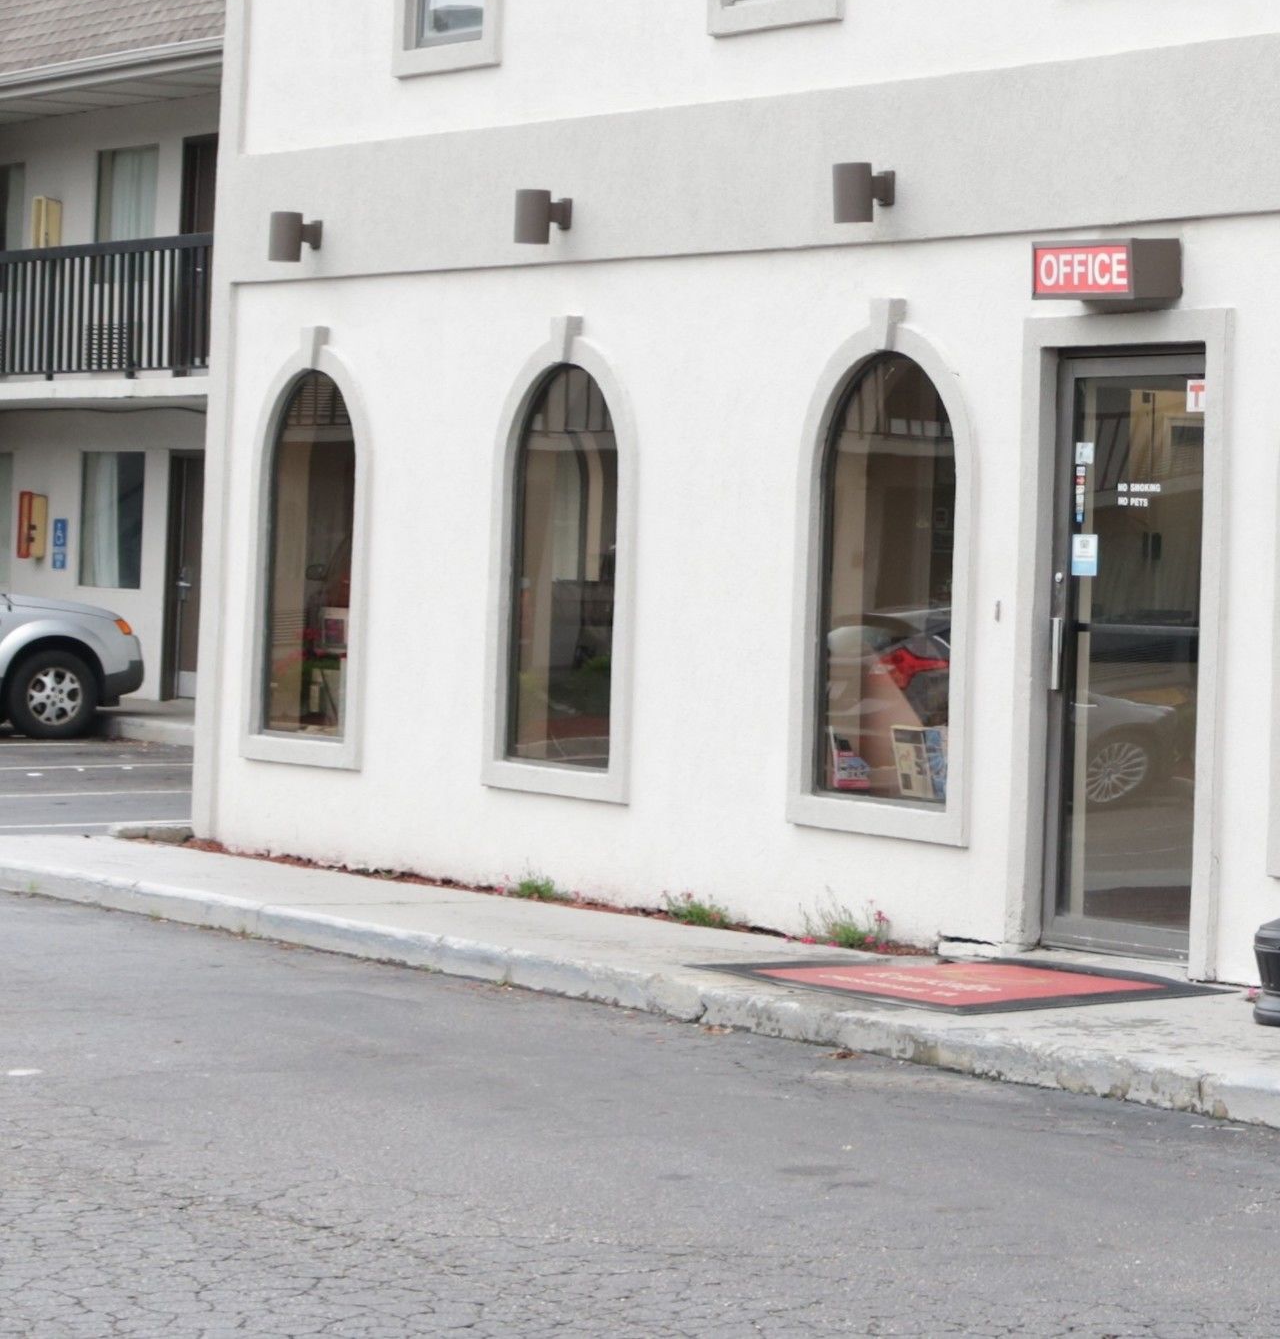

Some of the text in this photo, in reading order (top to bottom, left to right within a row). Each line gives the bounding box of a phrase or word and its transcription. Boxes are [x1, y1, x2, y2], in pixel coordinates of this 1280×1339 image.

[1040, 253, 1128, 287] OFFICE
[1117, 483, 1161, 492] NO SMOKING
[1117, 497, 1149, 507] NO PETS
